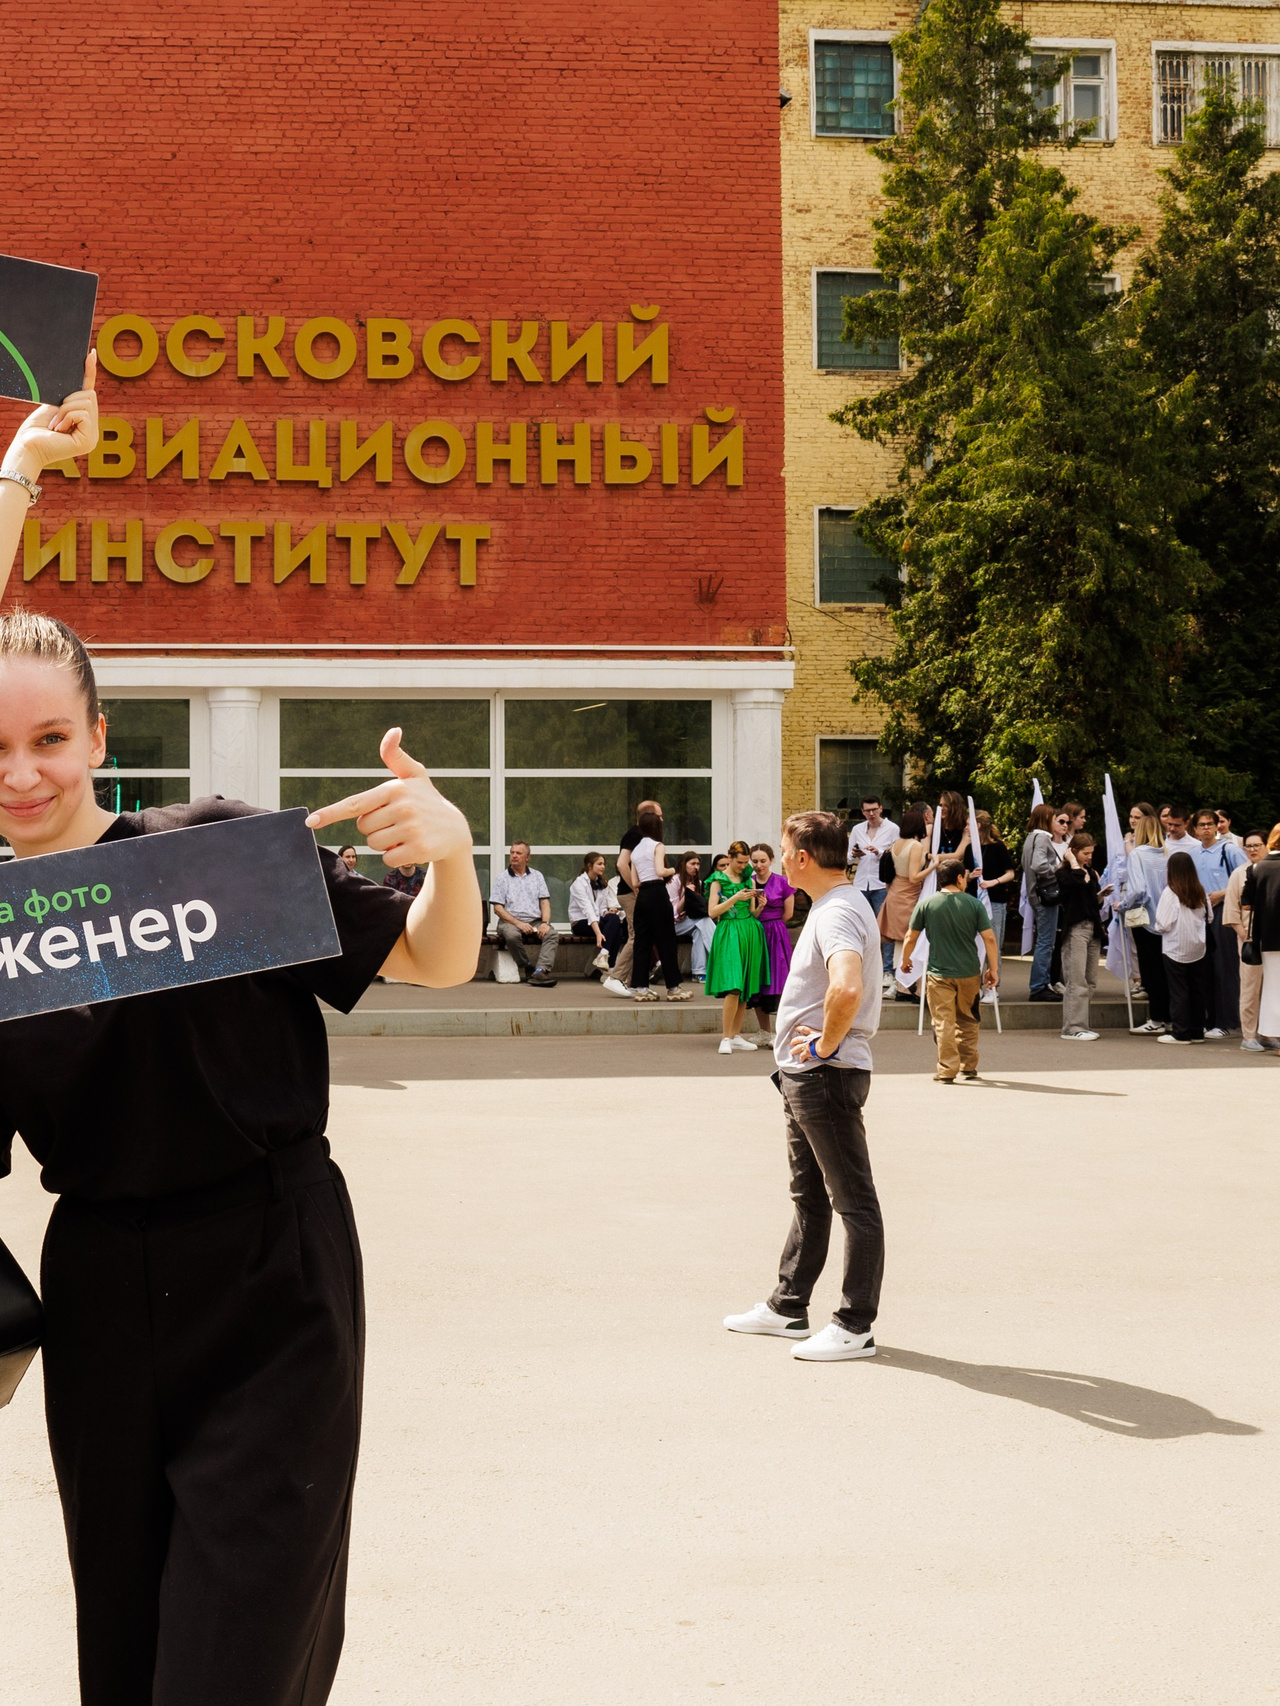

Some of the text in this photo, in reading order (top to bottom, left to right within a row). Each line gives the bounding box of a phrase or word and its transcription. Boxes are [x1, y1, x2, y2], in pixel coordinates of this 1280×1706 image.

[96, 303, 670, 384] ОСКОВСКИЙ
[22, 516, 492, 586] ИНСТИТУТ
[23, 883, 112, 924] фото
